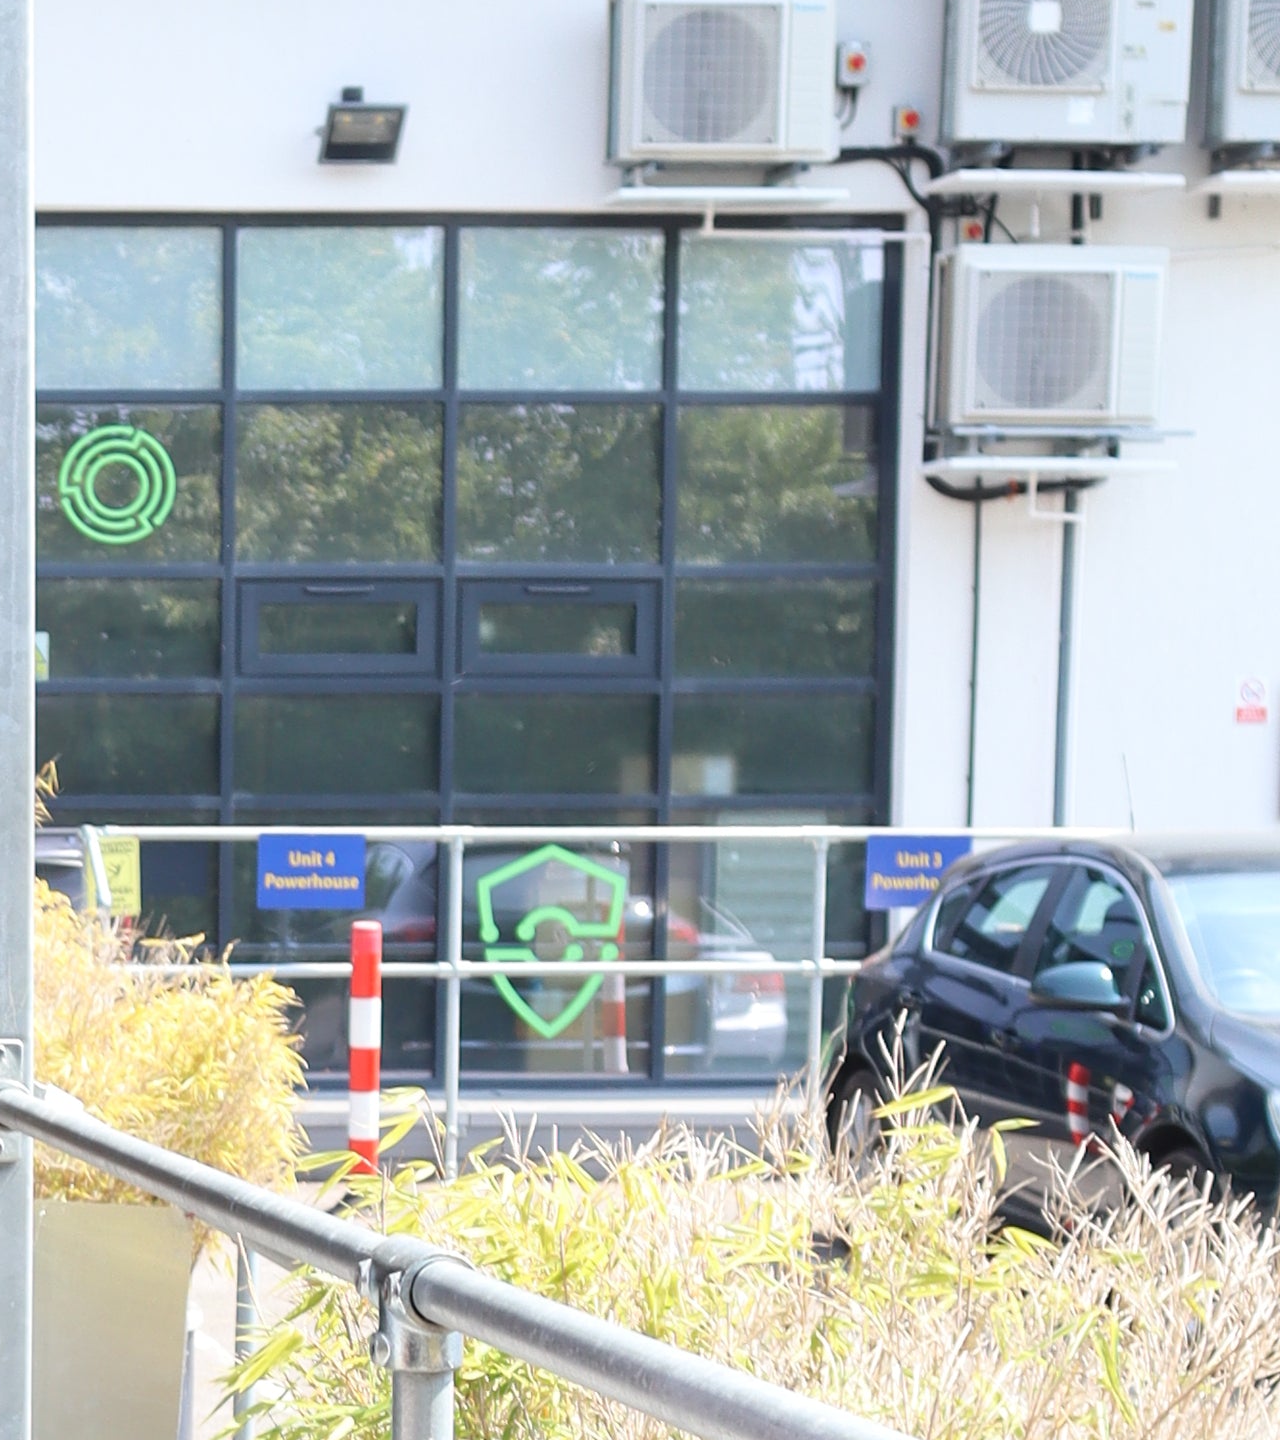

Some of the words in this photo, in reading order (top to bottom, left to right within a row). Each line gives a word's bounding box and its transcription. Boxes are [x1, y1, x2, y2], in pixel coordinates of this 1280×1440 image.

[287, 849, 323, 868] Unit
[325, 849, 336, 868] 4
[896, 850, 931, 869] Unit
[264, 871, 360, 891] Powerhouse
[871, 871, 941, 891] Powerho
